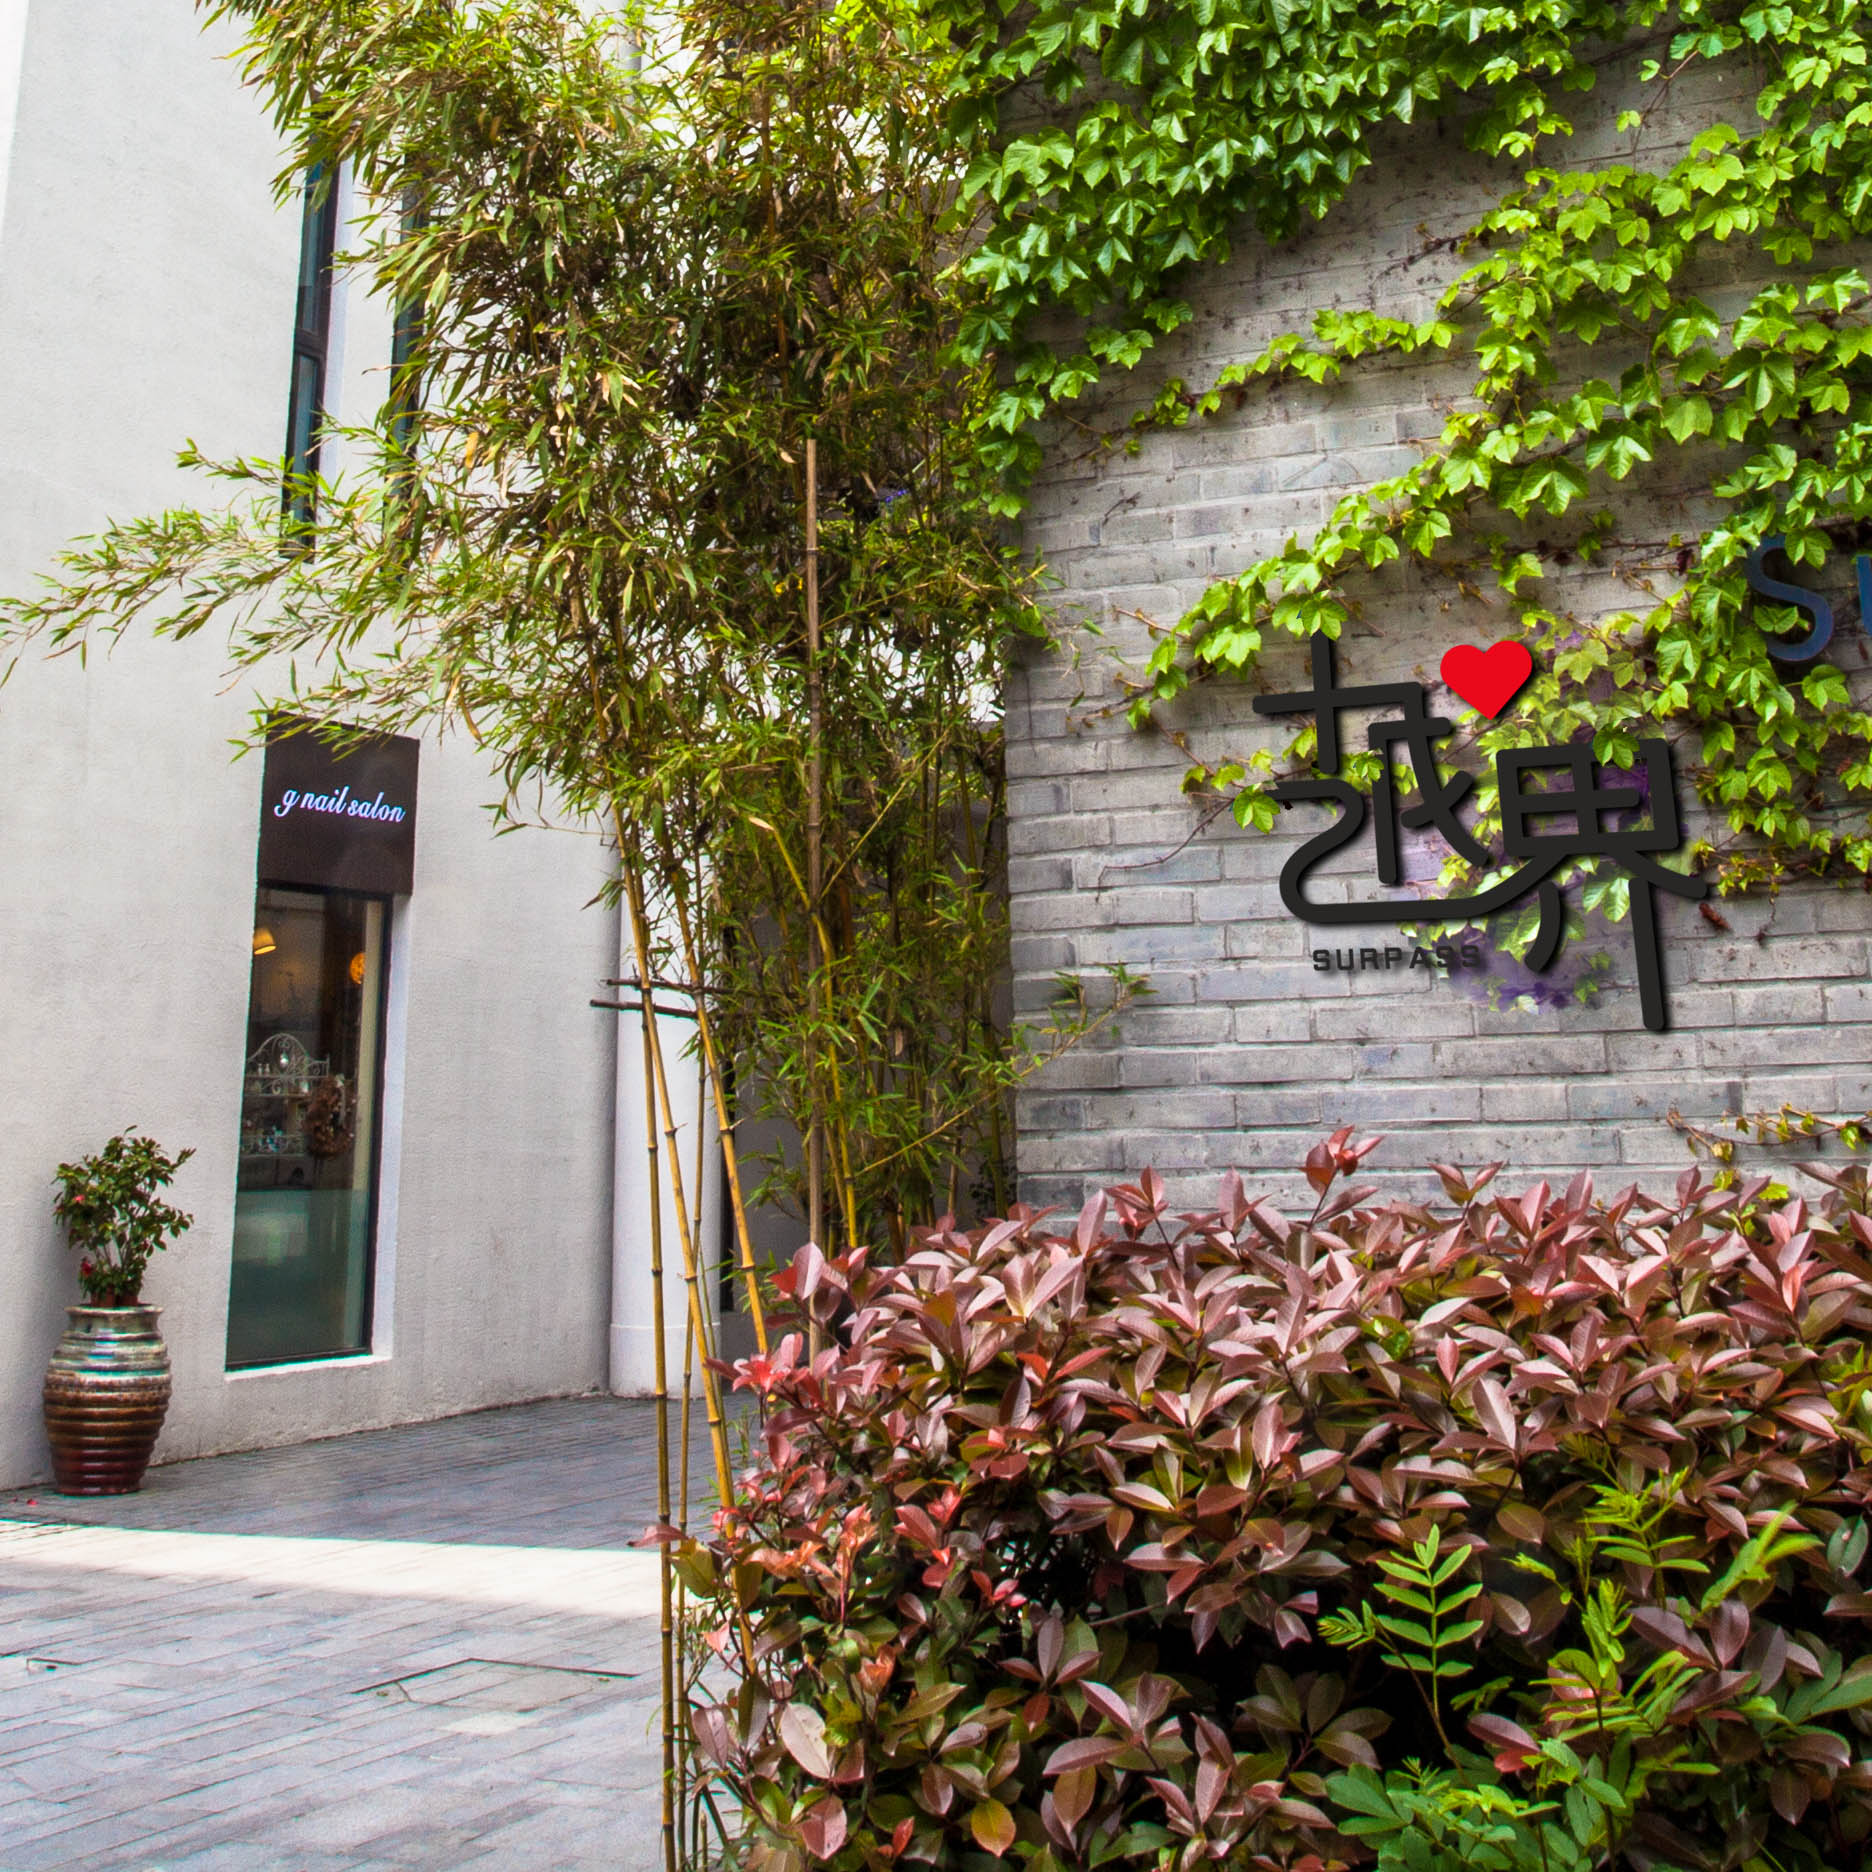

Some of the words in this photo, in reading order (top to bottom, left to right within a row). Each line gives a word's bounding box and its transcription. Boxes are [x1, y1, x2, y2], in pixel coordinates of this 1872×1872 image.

[273, 789, 300, 817] g
[300, 784, 350, 815] nail
[347, 791, 406, 823] salon
[1312, 945, 1481, 972] SURPASS
